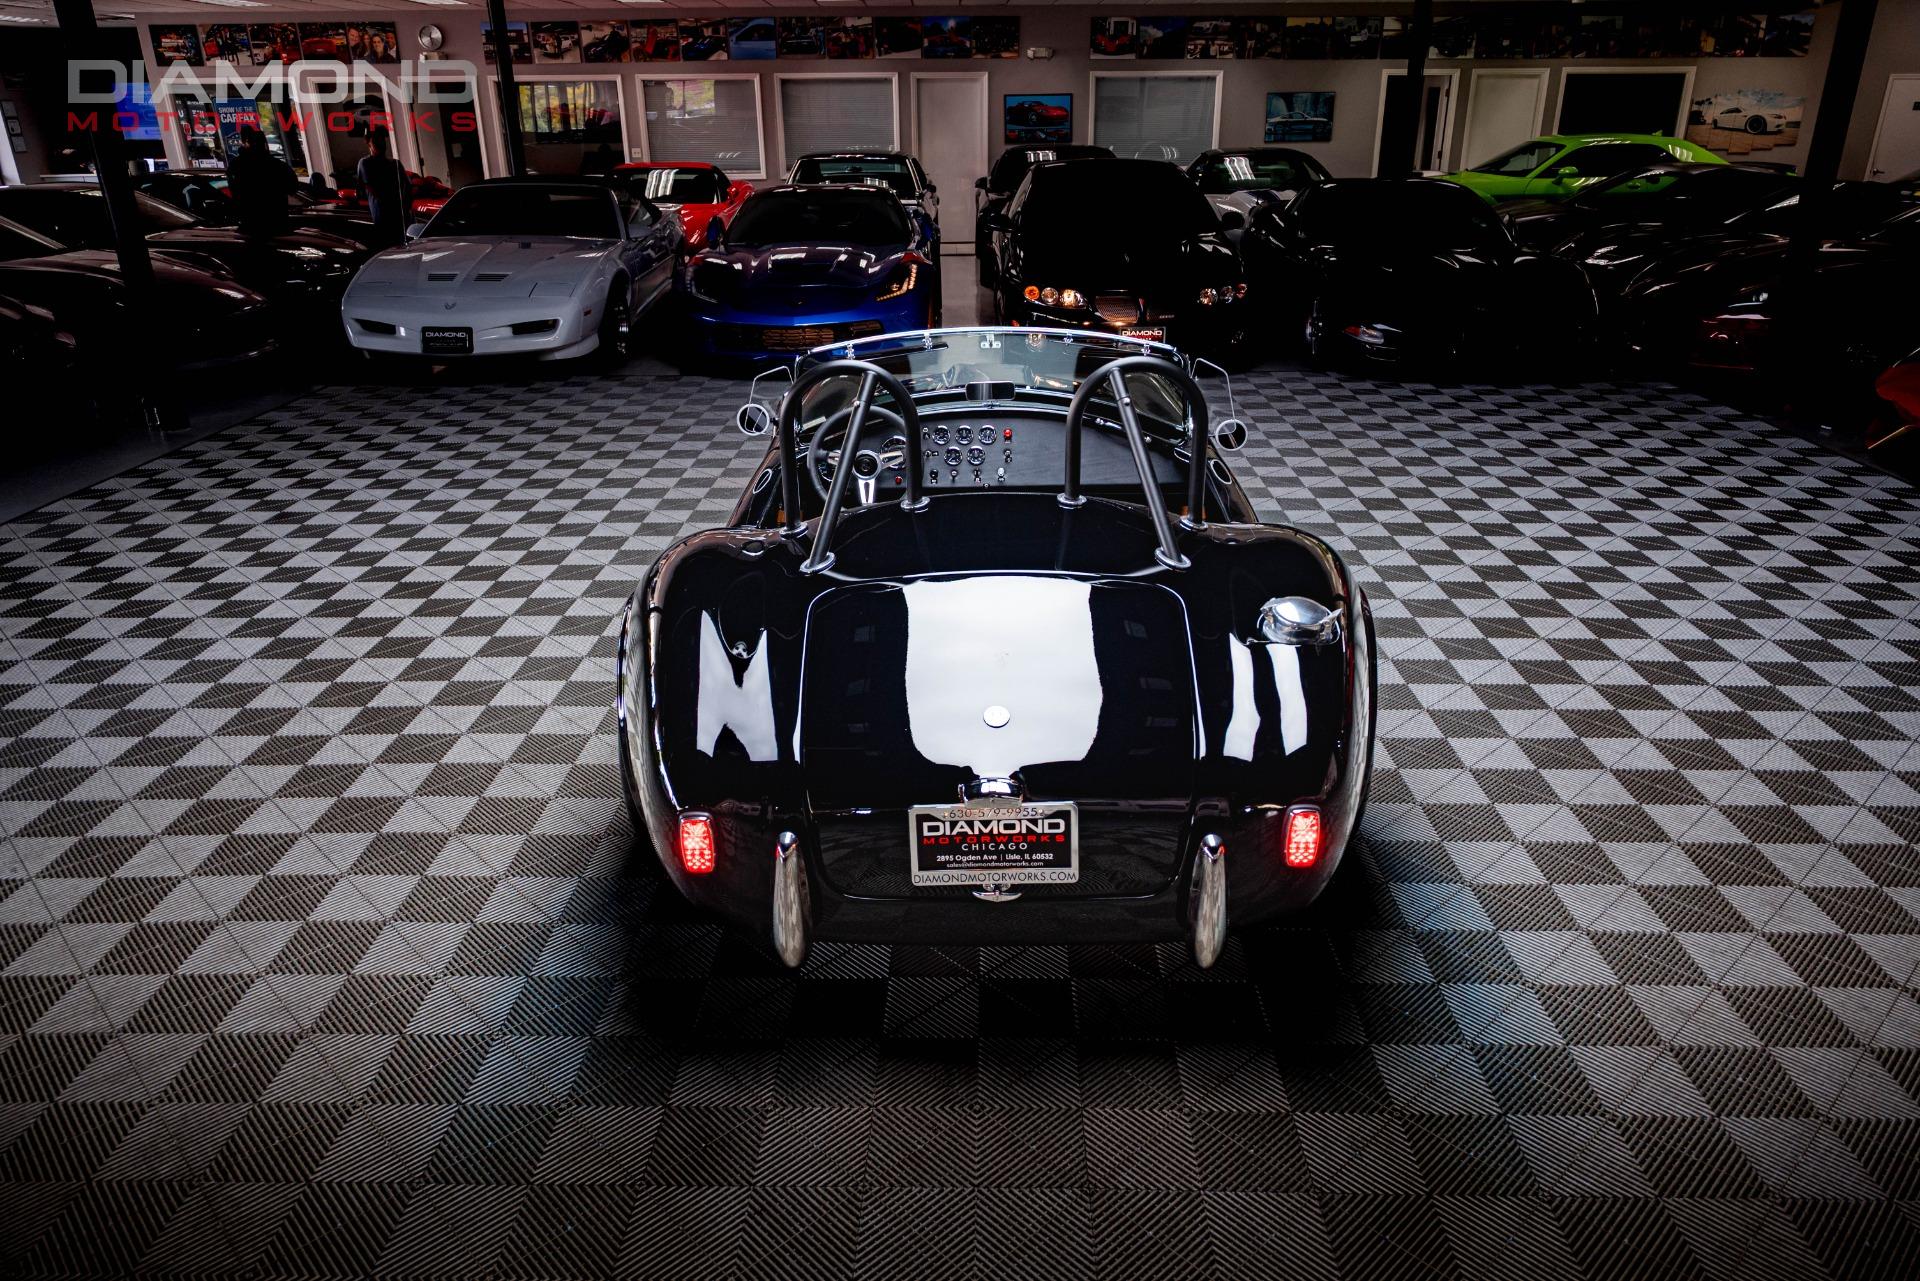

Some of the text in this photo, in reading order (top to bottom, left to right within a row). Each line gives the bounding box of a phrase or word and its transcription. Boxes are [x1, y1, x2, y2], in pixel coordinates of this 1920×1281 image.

[220, 113, 255, 123] CARFAX
[922, 818, 1066, 836] DIAMOND
[923, 835, 1065, 844] MOTORWORKS
[961, 842, 1028, 851] CHICAGO
[955, 854, 981, 863] Ogden
[914, 871, 1077, 884] DIAMONDMOTORWORKS.COM
